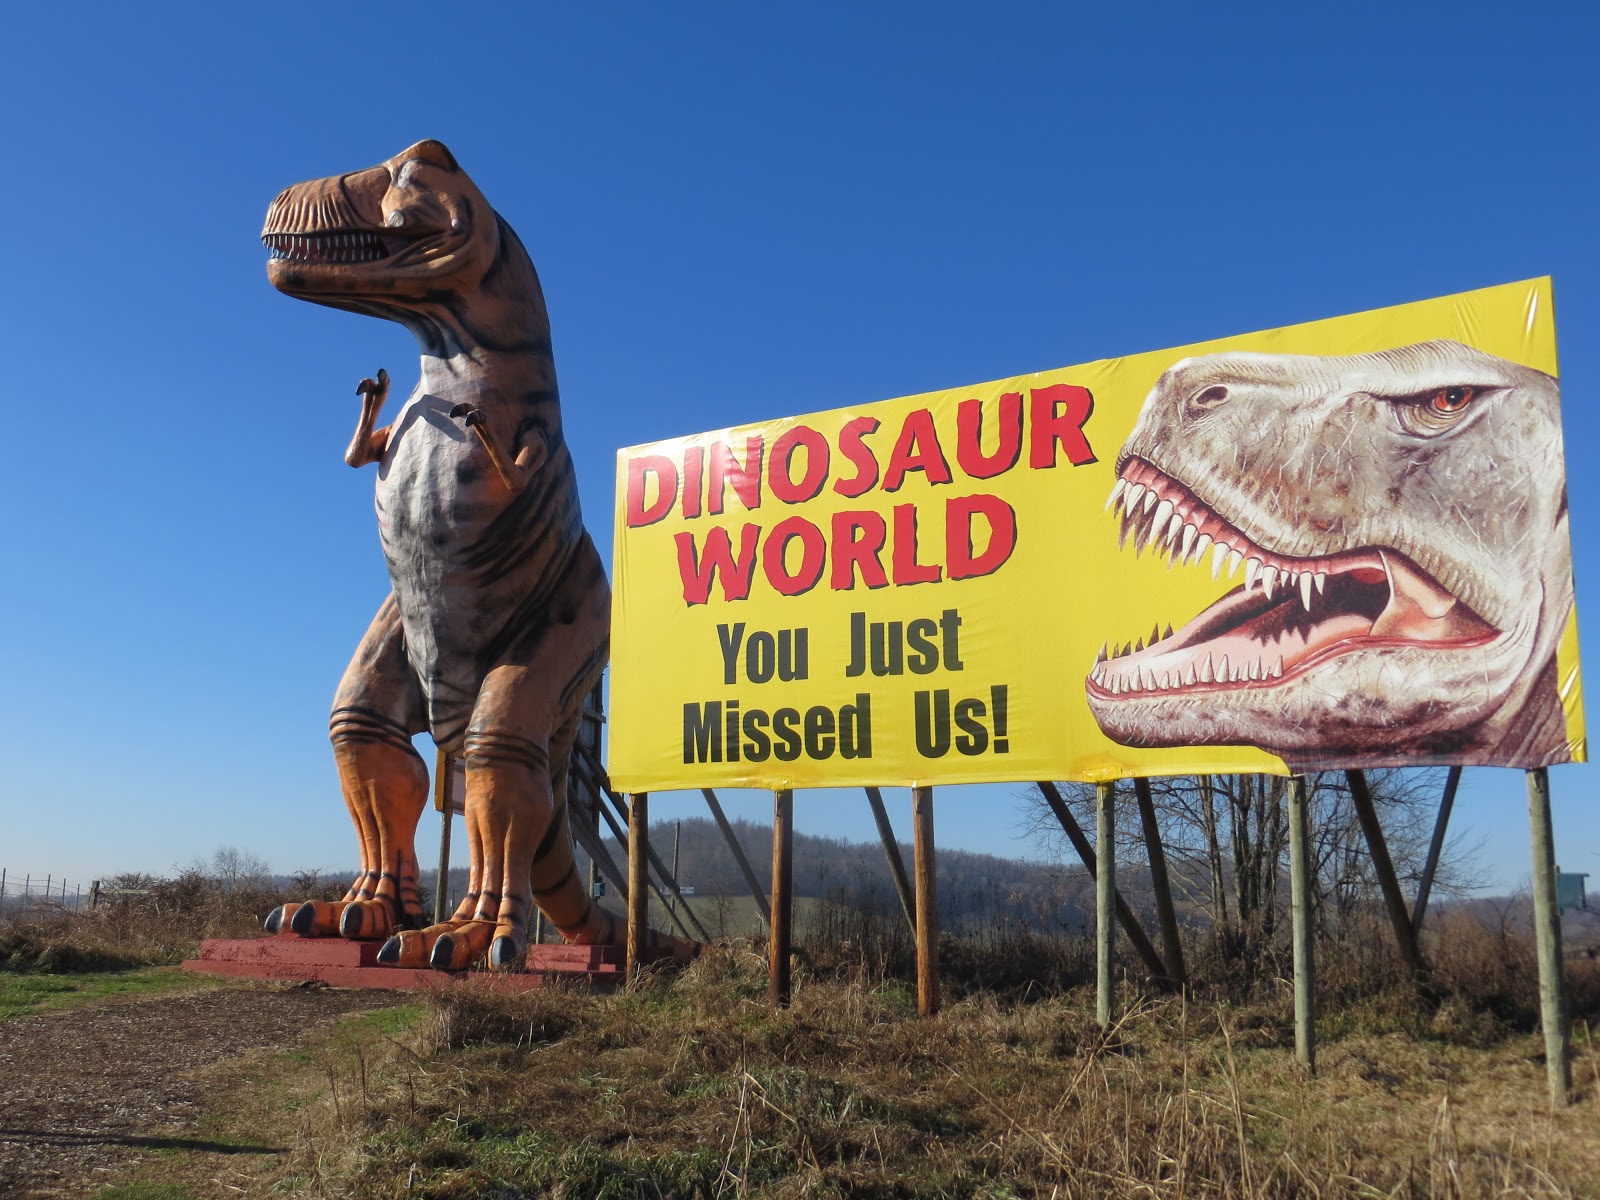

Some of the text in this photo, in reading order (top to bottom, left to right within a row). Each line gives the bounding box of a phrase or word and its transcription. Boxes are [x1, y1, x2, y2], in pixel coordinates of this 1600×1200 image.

[626, 383, 1098, 527] DINOSAUR
[674, 493, 1018, 607] WORLD
[717, 608, 964, 685] You Just
[682, 684, 1009, 764] Missed Us!
